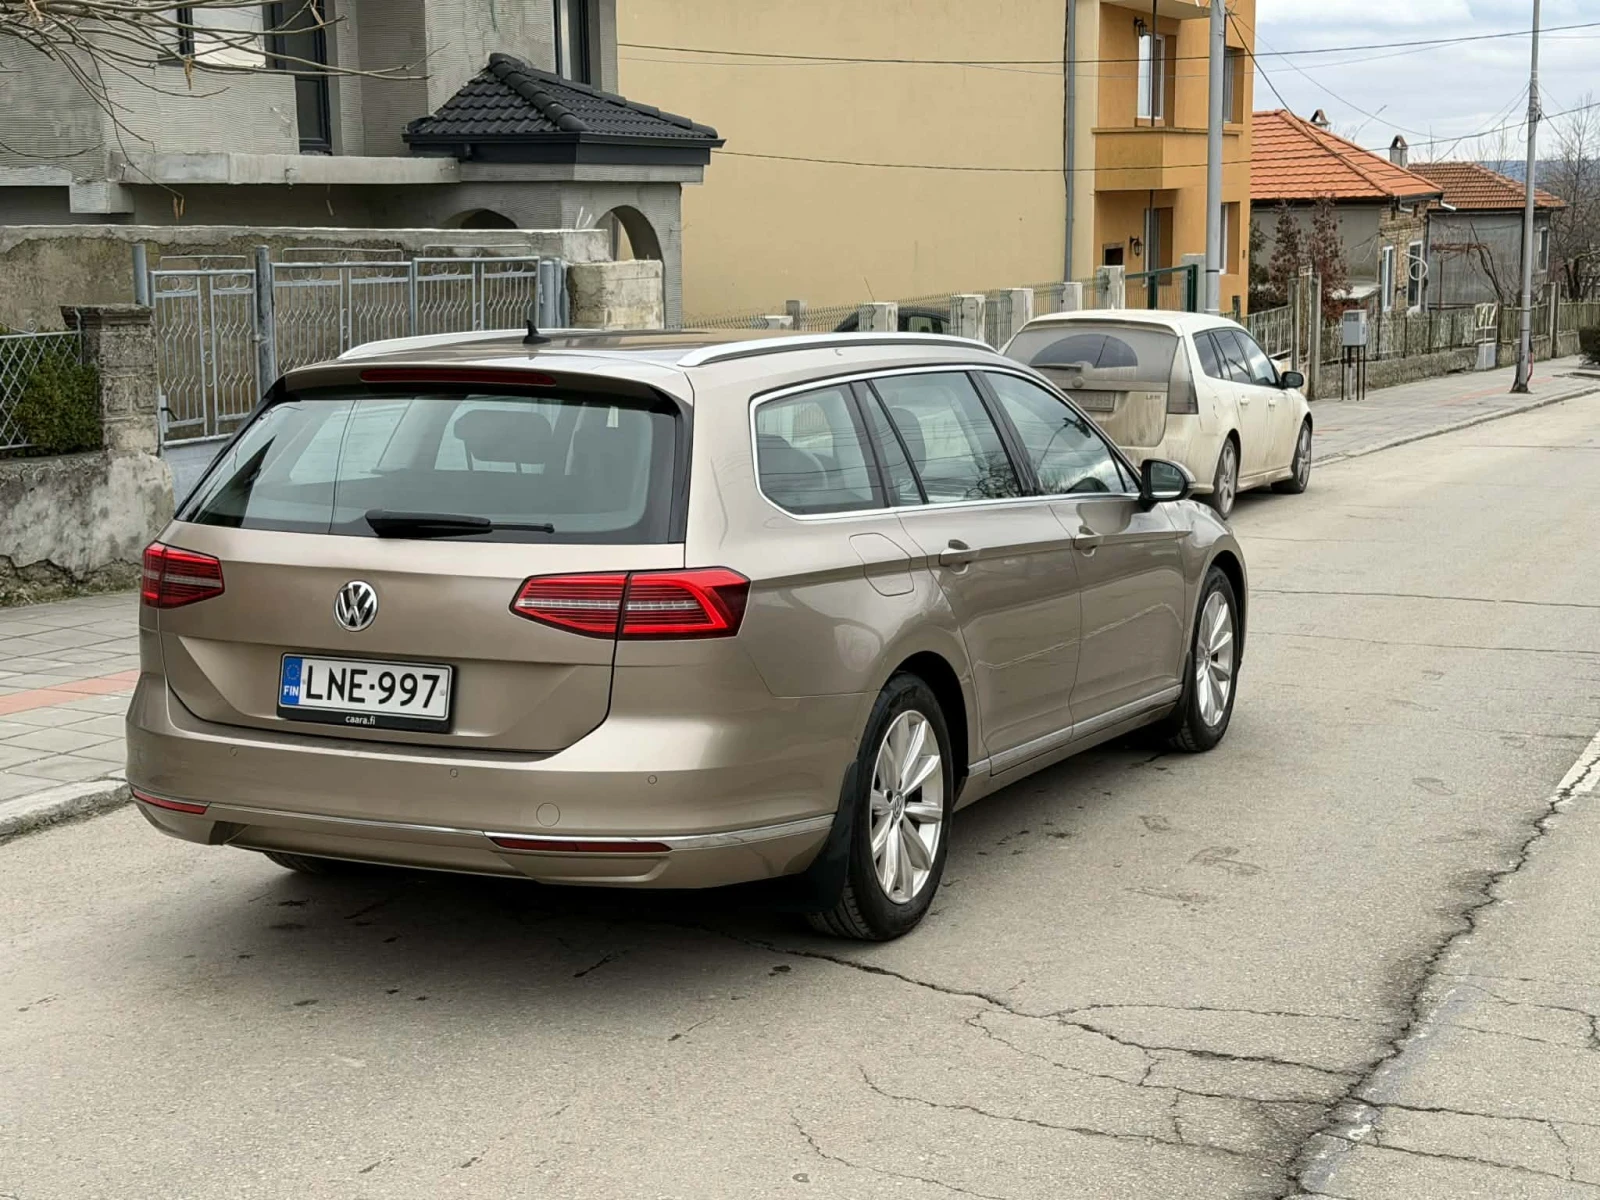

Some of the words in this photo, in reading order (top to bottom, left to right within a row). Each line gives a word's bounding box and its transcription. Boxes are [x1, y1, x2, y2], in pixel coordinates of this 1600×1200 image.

[283, 685, 299, 697] FIN
[305, 665, 440, 709] LNE-997
[345, 715, 376, 725] caara.fi
